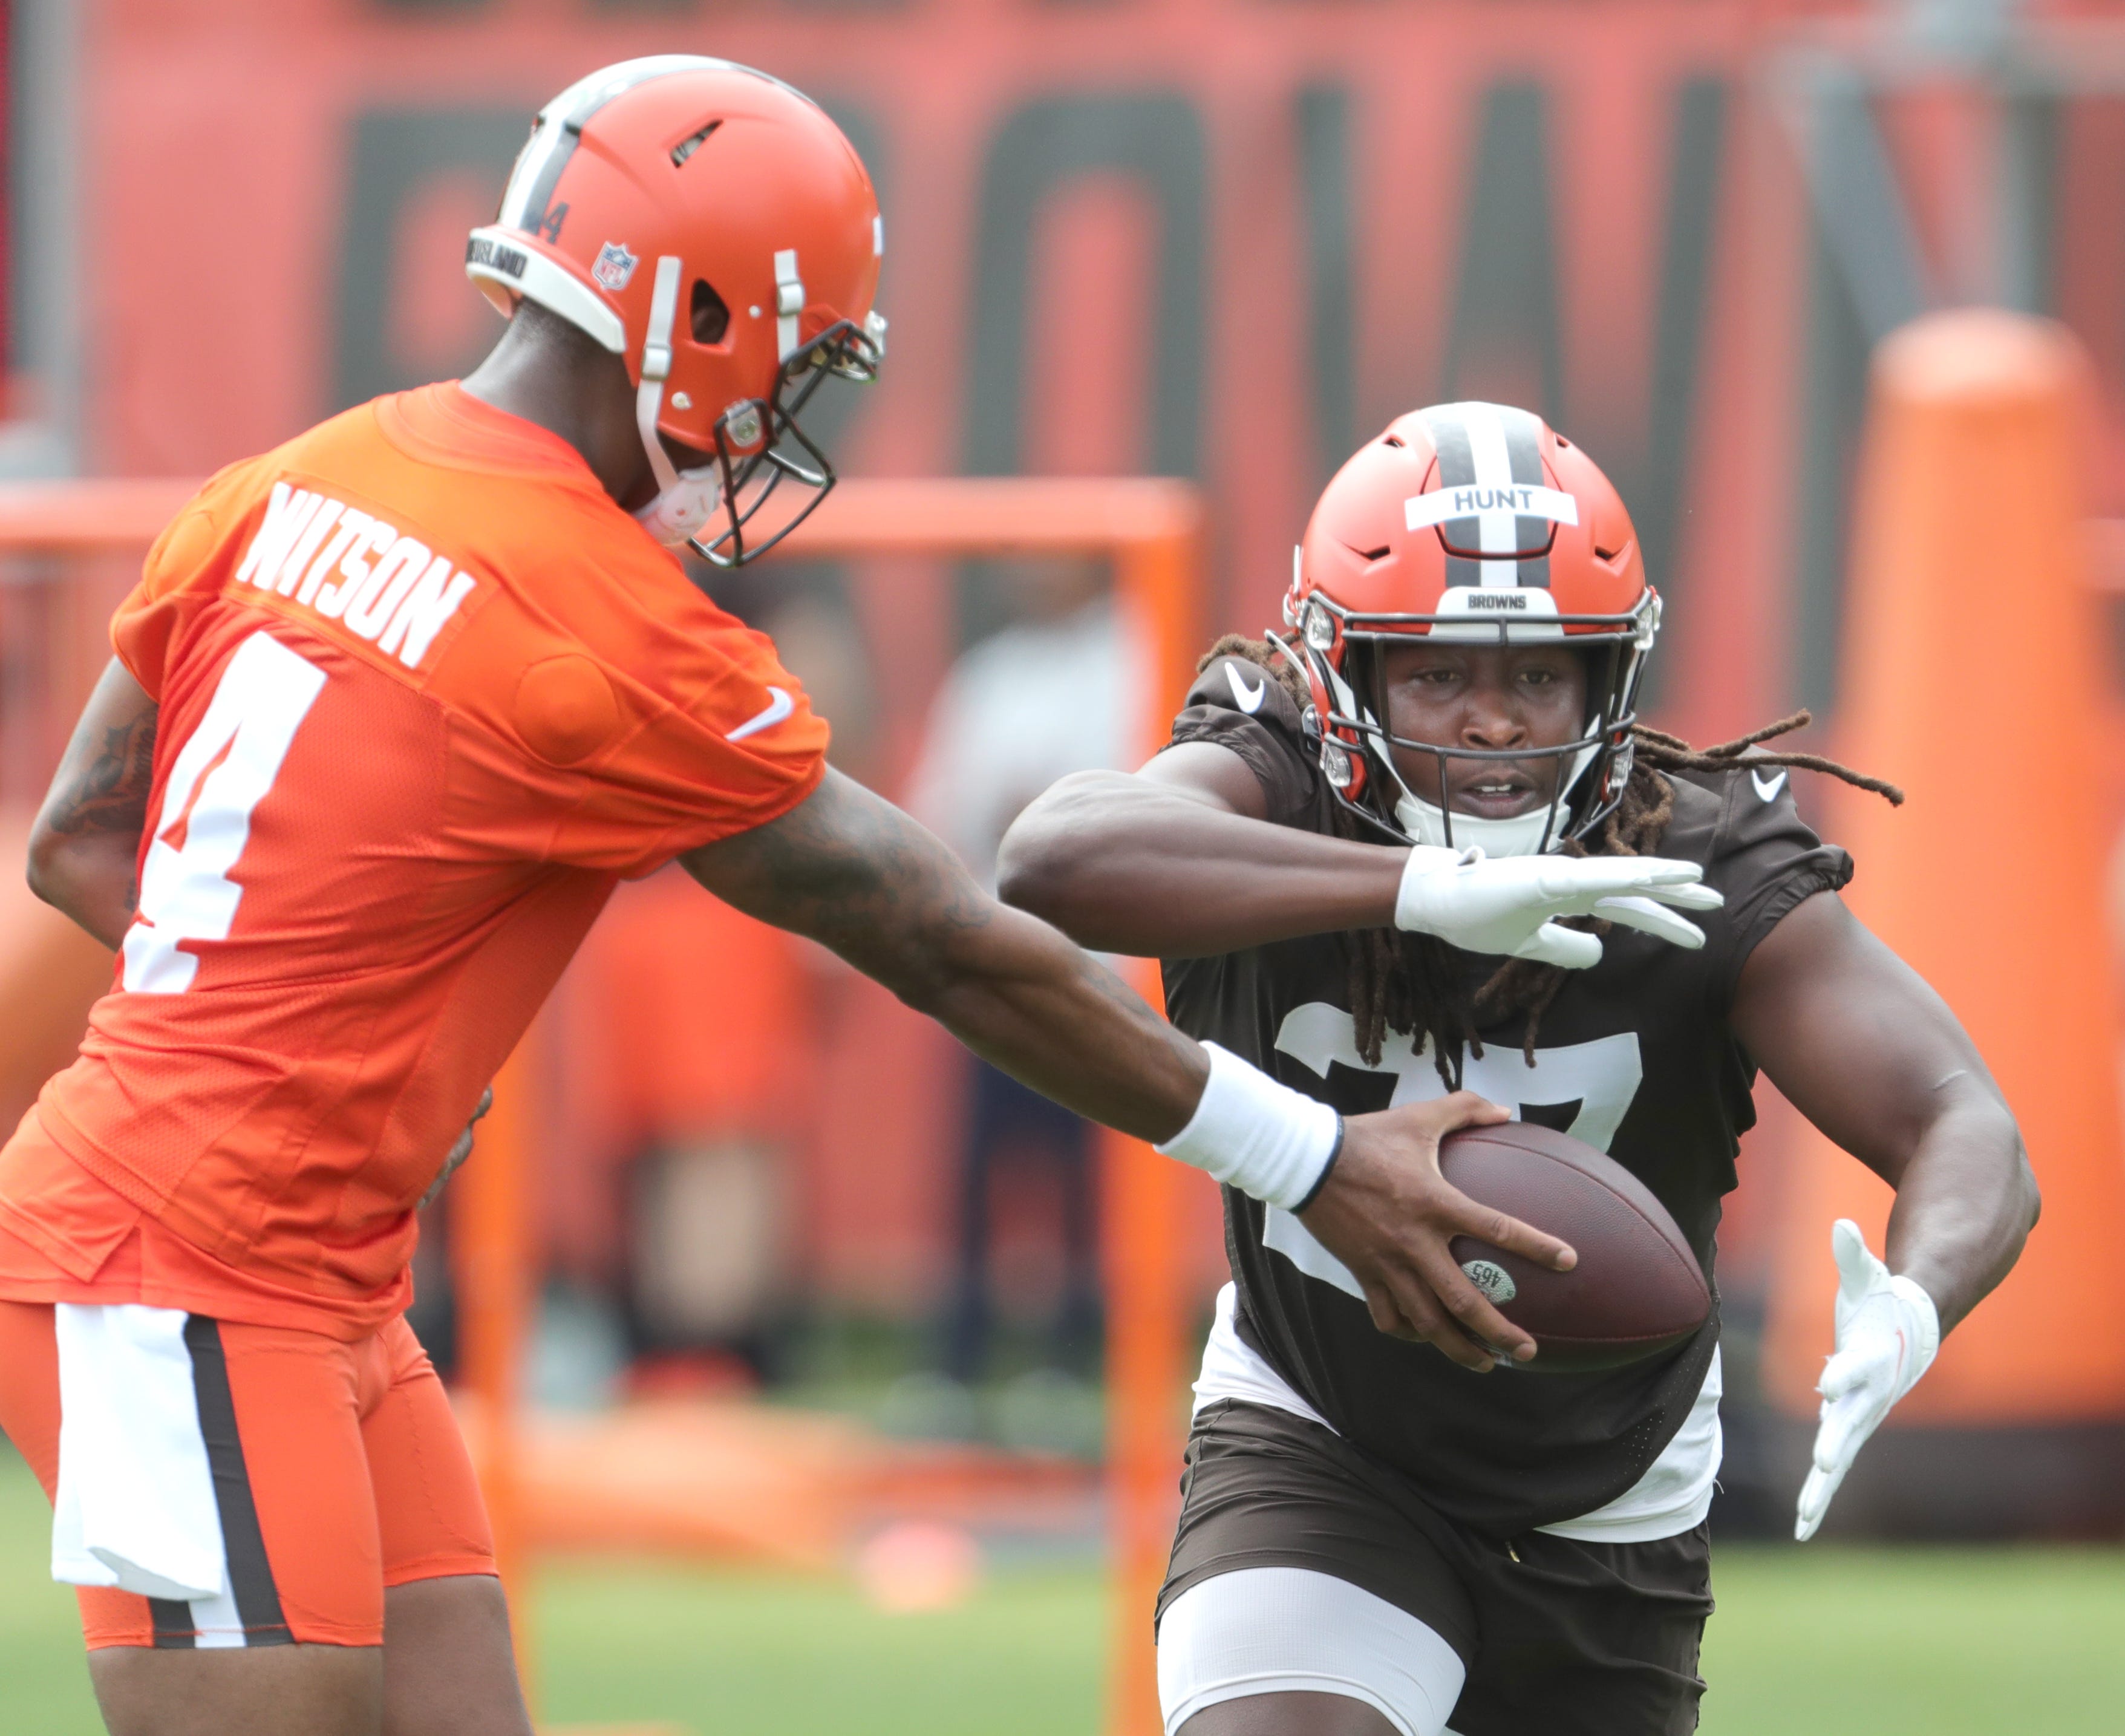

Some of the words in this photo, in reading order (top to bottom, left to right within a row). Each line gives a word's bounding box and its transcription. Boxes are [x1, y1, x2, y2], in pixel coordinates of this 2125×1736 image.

[1454, 489, 1533, 512] HUNT
[1467, 593, 1527, 610] BROWNS
[122, 630, 328, 993] 4
[1470, 1263, 1501, 1288] 465
